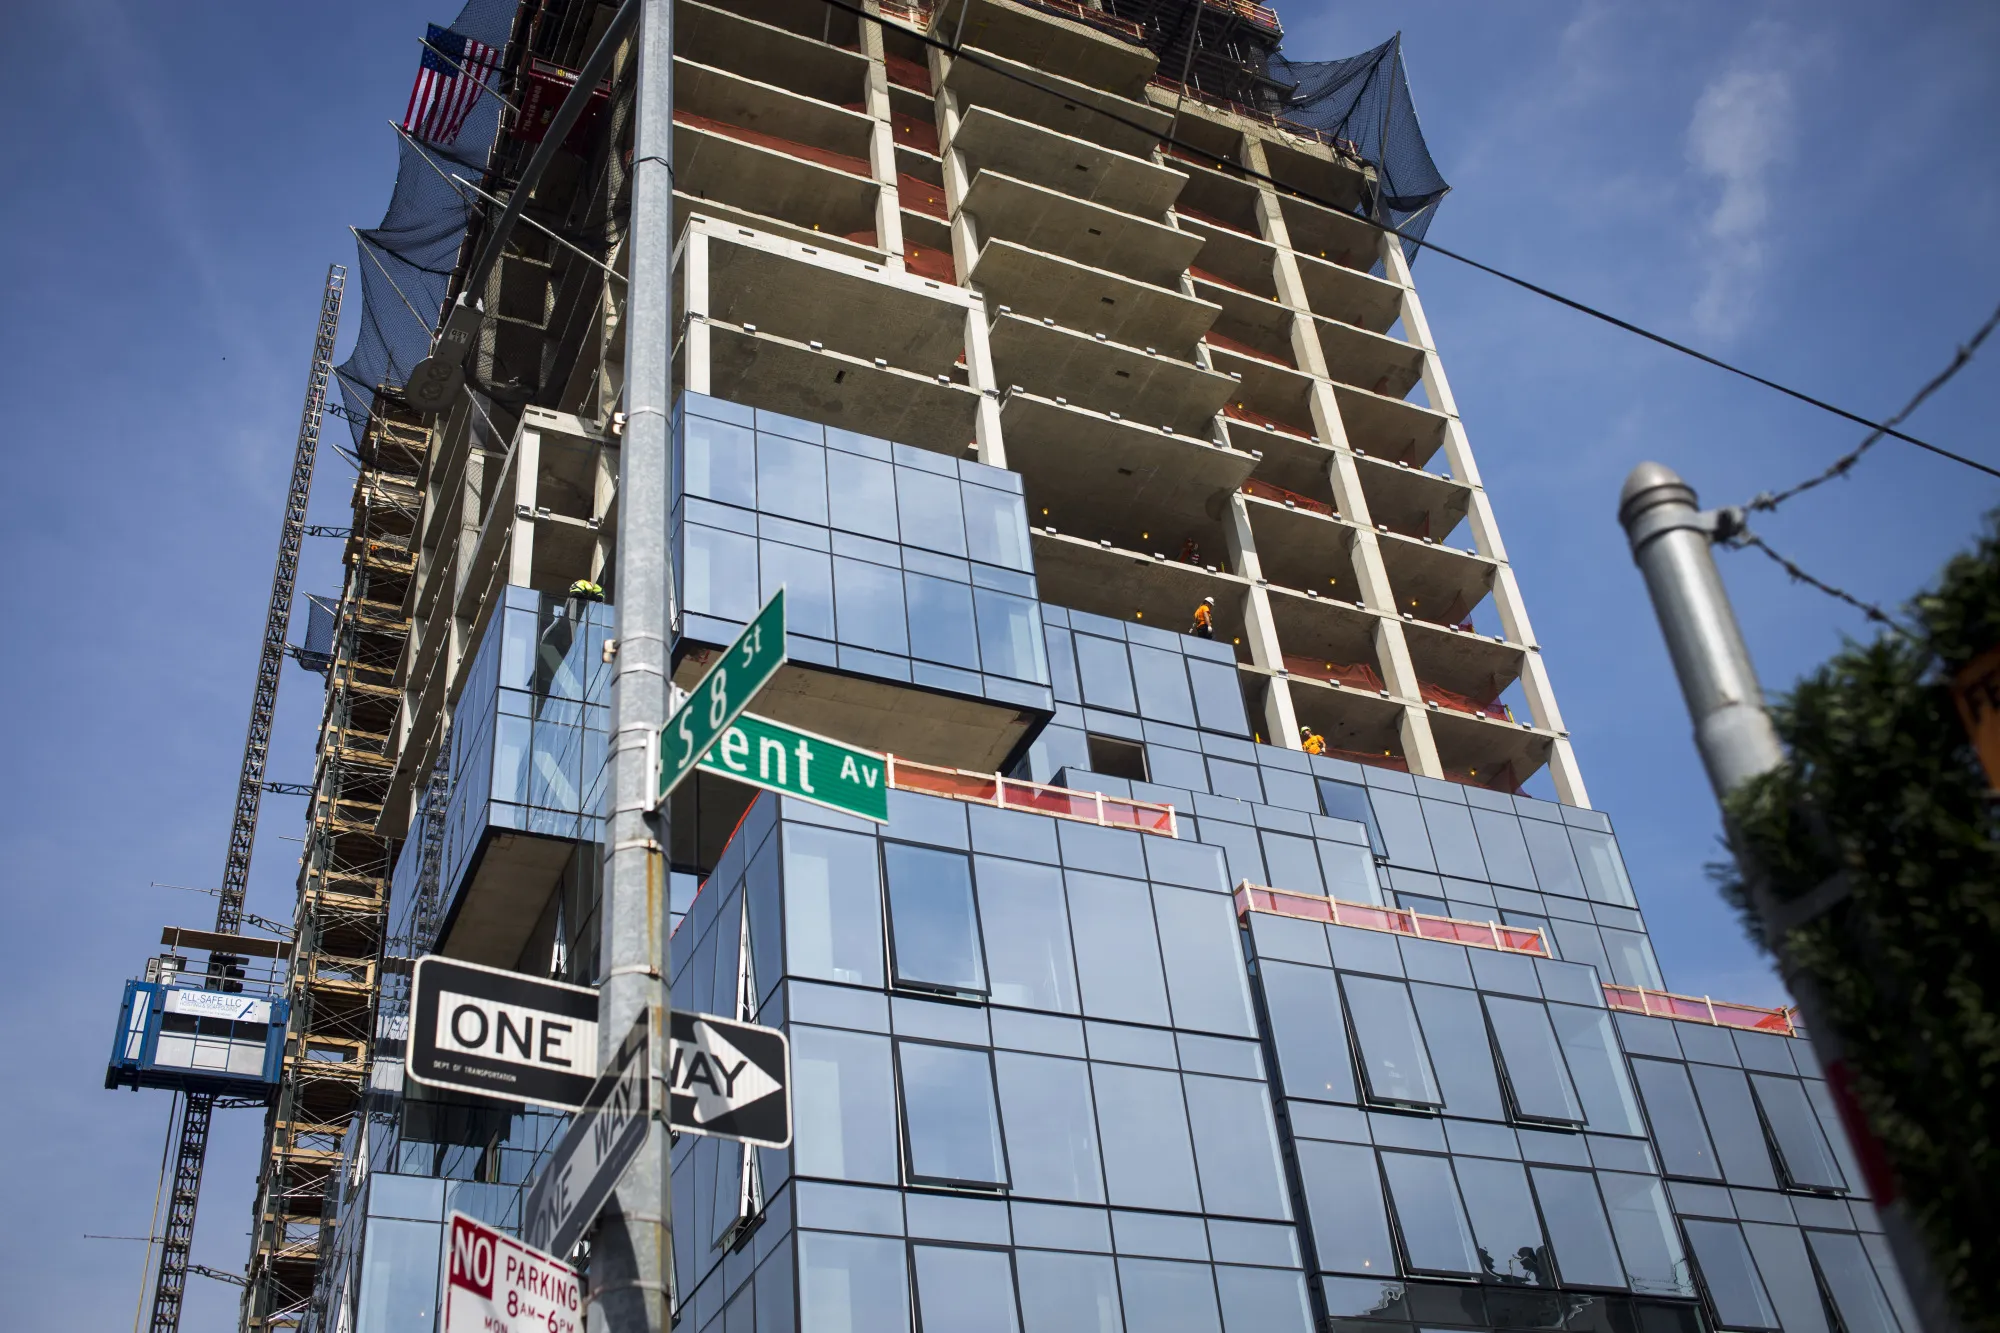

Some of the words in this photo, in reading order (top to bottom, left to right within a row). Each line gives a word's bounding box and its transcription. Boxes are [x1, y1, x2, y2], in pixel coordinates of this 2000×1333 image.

[678, 705, 694, 770] S
[710, 667, 727, 730] 8
[742, 624, 762, 669] St
[840, 755, 878, 789] Av
[180, 992, 224, 1006] ALL-SAFE
[225, 997, 242, 1008] LLC
[451, 1003, 573, 1068] ONE
[464, 1066, 517, 1082] TRANSPORTATION
[535, 1164, 573, 1251] ONE
[594, 1062, 636, 1167] WAY
[453, 1226, 492, 1287] NO
[506, 1255, 577, 1311] PARKING
